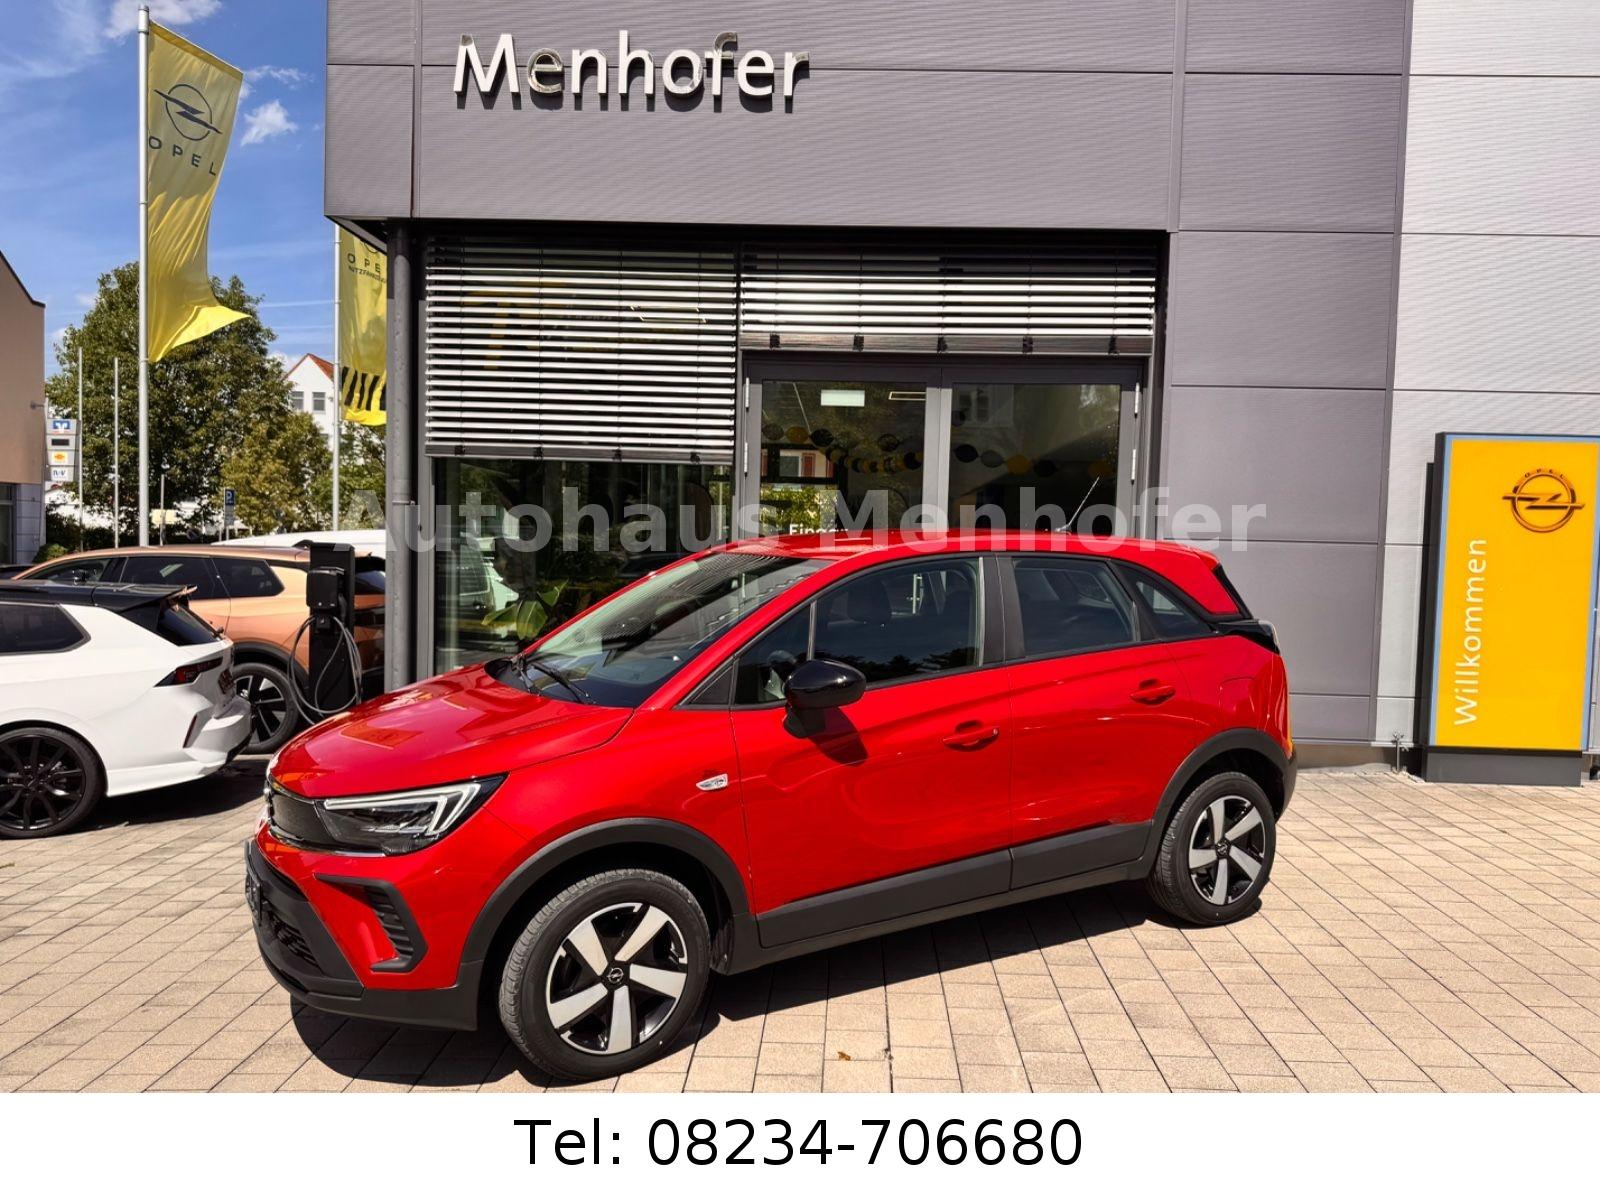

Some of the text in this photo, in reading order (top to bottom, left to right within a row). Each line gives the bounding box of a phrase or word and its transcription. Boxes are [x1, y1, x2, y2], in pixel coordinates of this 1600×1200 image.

[453, 29, 810, 97] Menhofer
[148, 135, 217, 177] OPEL
[1524, 468, 1565, 480] OPEL
[1453, 539, 1488, 726] Willkommen
